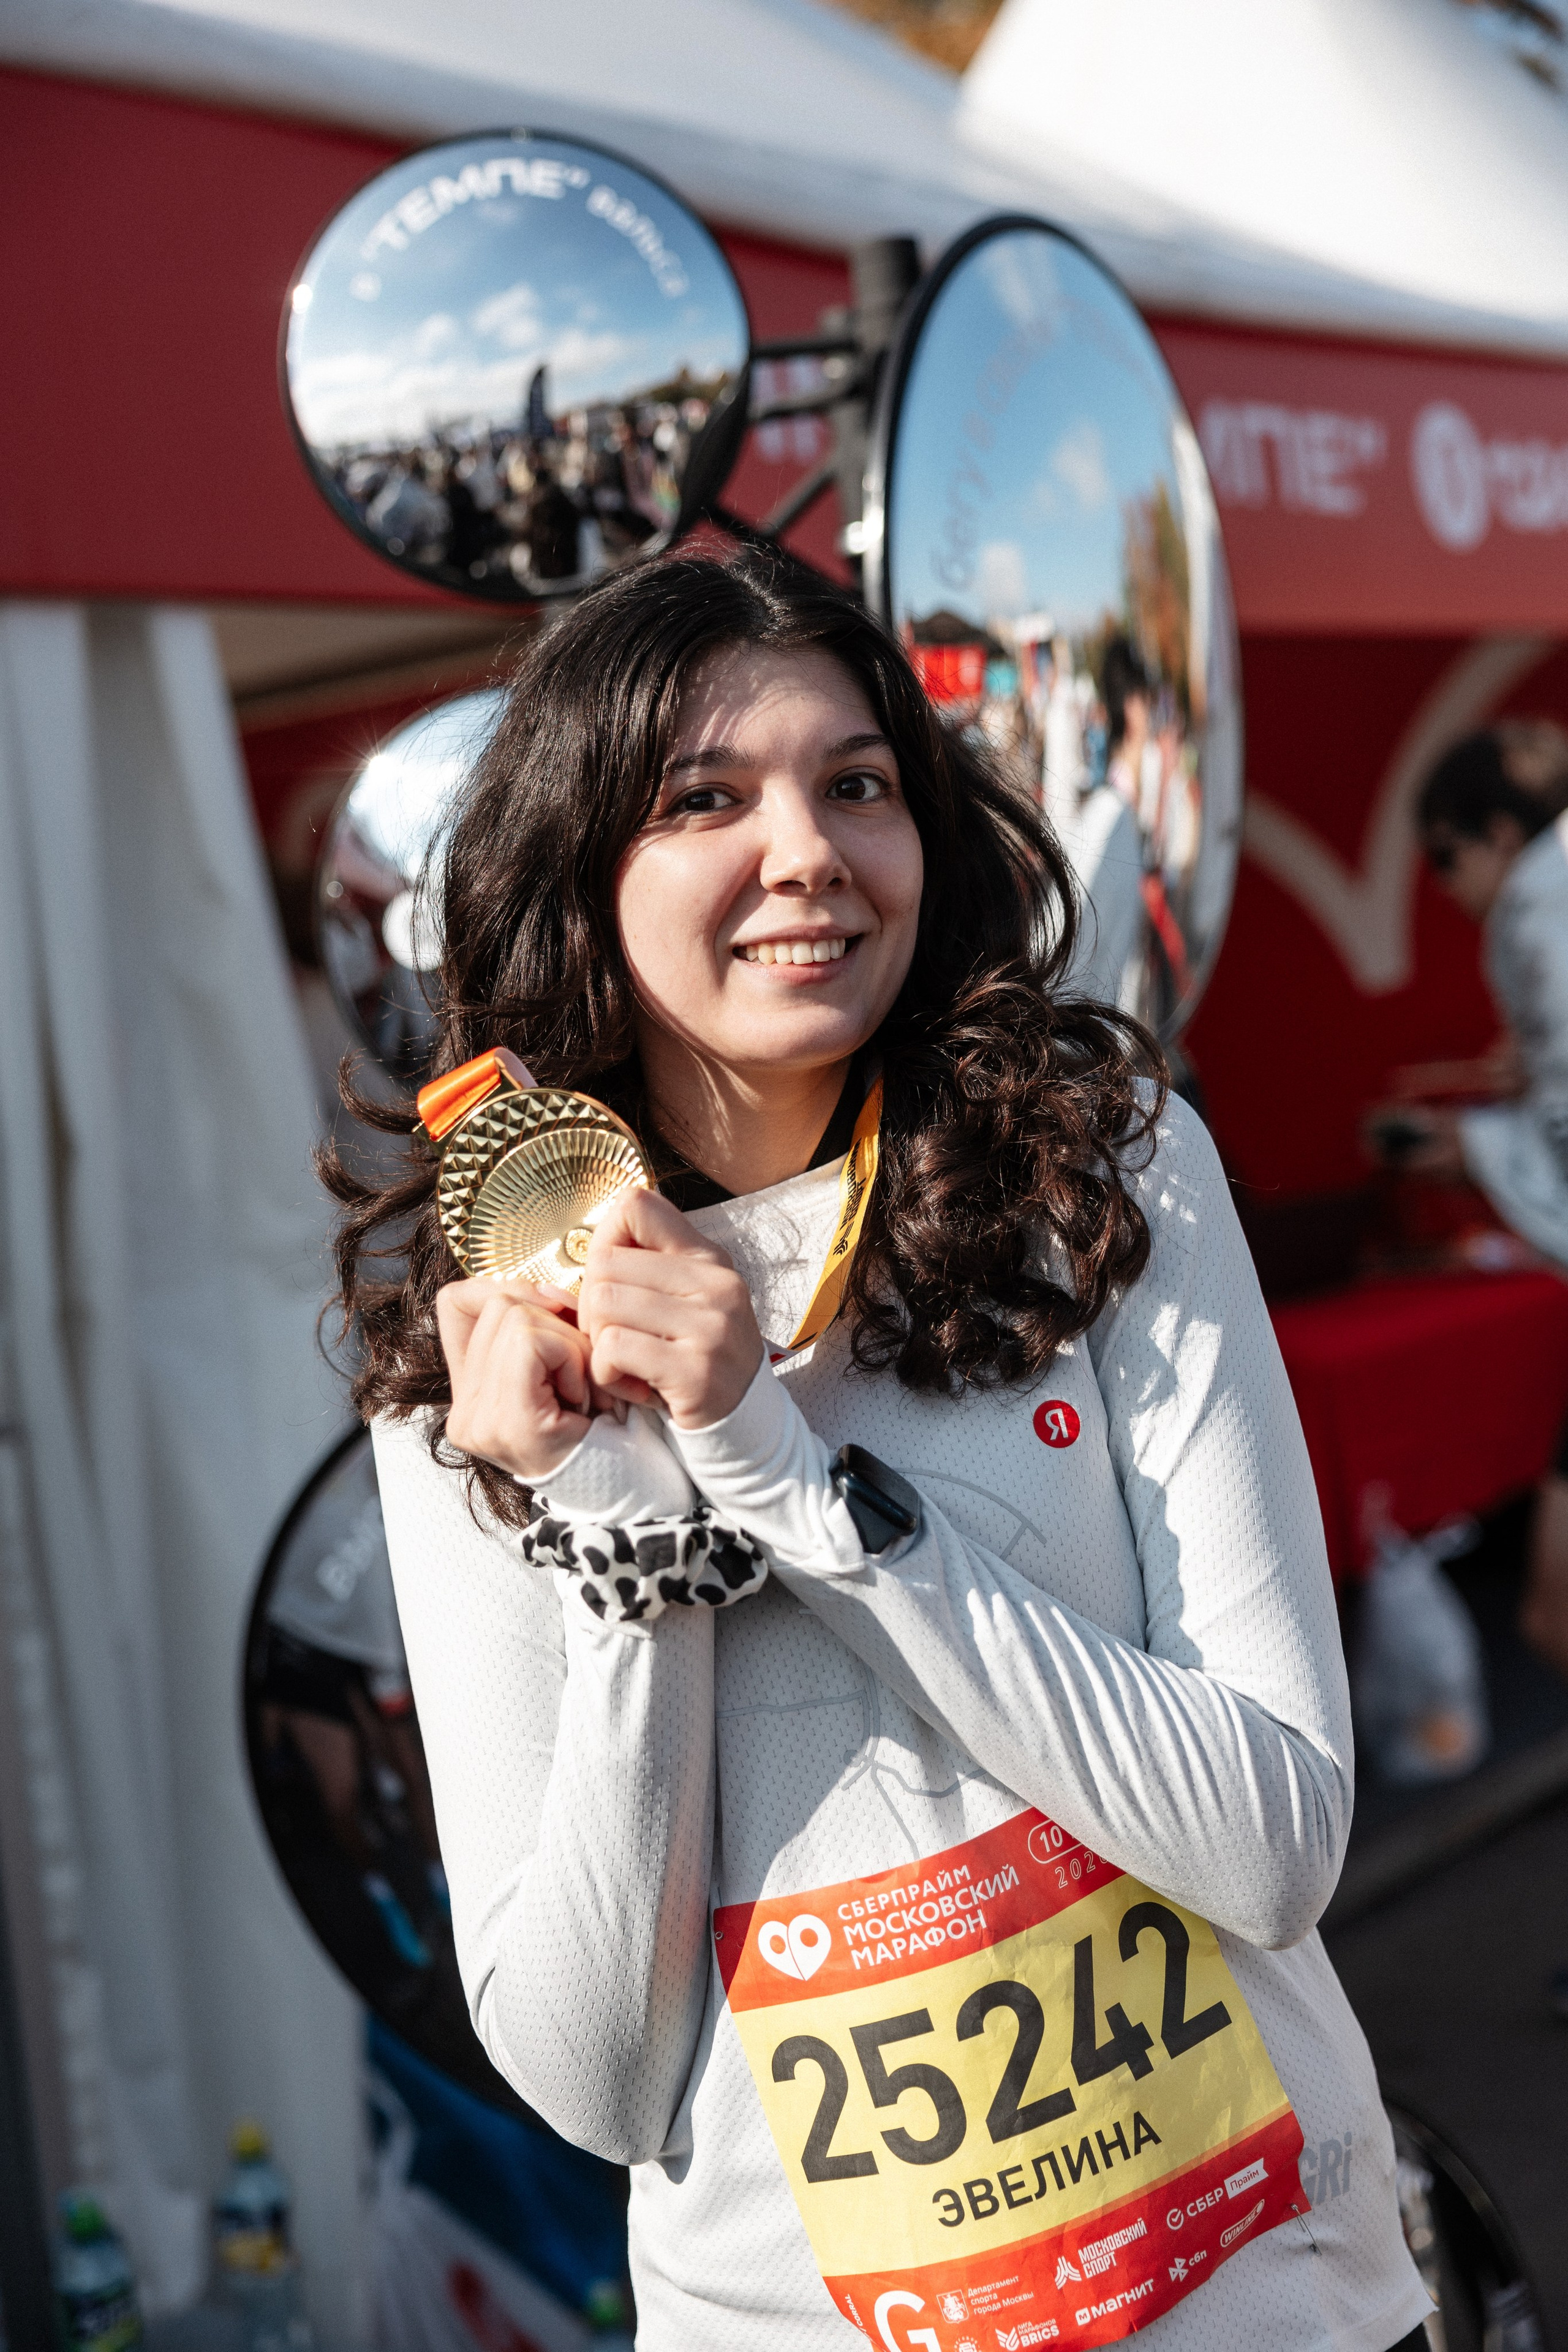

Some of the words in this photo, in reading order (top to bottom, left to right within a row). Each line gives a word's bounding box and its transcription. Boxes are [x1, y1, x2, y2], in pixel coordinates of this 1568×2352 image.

[1045, 1408, 1069, 1441] Я
[1039, 1825, 1063, 1853] 10
[837, 1865, 971, 1920] СБЕРПРАЙМ
[843, 1864, 1020, 1946] МОСКОВСКИЙ
[851, 1909, 987, 1970] МАРАФОН
[771, 1901, 1232, 2183] 25242
[932, 2111, 1162, 2228] ЭВЕЛИНА
[1186, 2187, 1224, 2217] СБЕР
[1230, 2170, 1259, 2190] Прайм
[1078, 2217, 1147, 2264] МОСКОВСКИЙ
[1224, 2209, 1257, 2244] WINLINE
[1083, 2251, 1117, 2278] СПОРТ
[1189, 2250, 1207, 2266] сбп
[968, 2275, 1019, 2297] Департамент
[971, 2293, 998, 2306] спорта
[845, 2293, 863, 2326] CORRAL
[974, 2302, 1001, 2315] города
[1002, 2291, 1034, 2307] Москвы
[874, 2290, 942, 2352] G
[1017, 2321, 1032, 2331] ЛИГА
[1018, 2318, 1057, 2335] МАРАФОНОВ
[1020, 2325, 1060, 2348] BRICS
